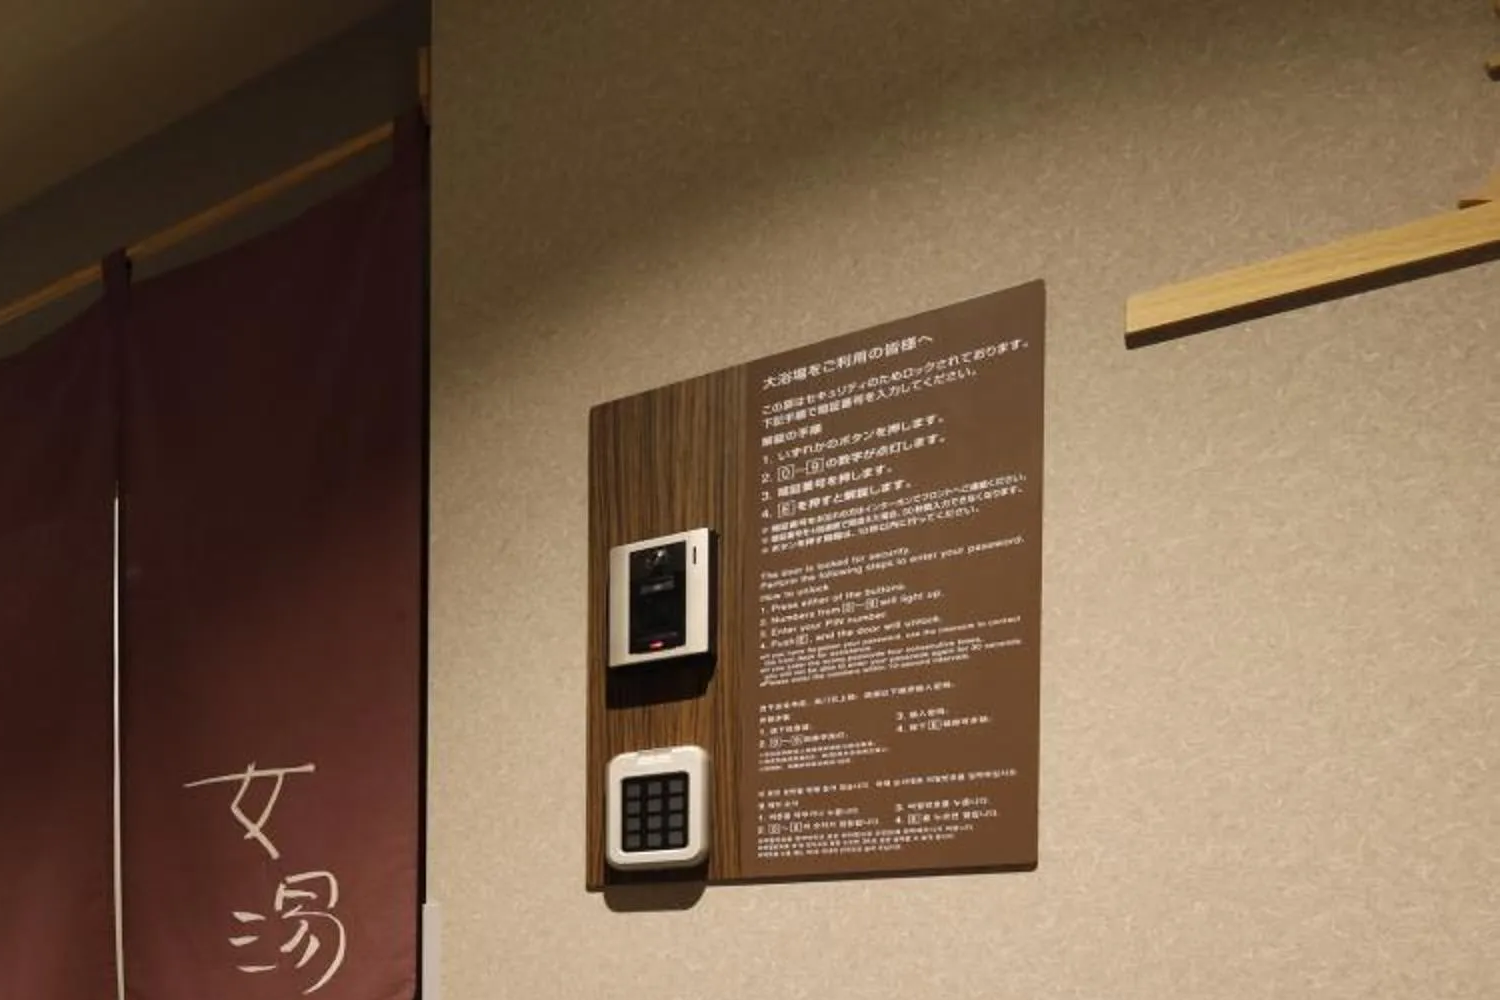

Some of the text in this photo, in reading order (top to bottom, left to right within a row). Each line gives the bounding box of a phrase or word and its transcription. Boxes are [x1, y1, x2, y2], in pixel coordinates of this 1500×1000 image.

[764, 336, 932, 390] 大浴場をご利用の皆様へ
[185, 763, 345, 993] 女湯
